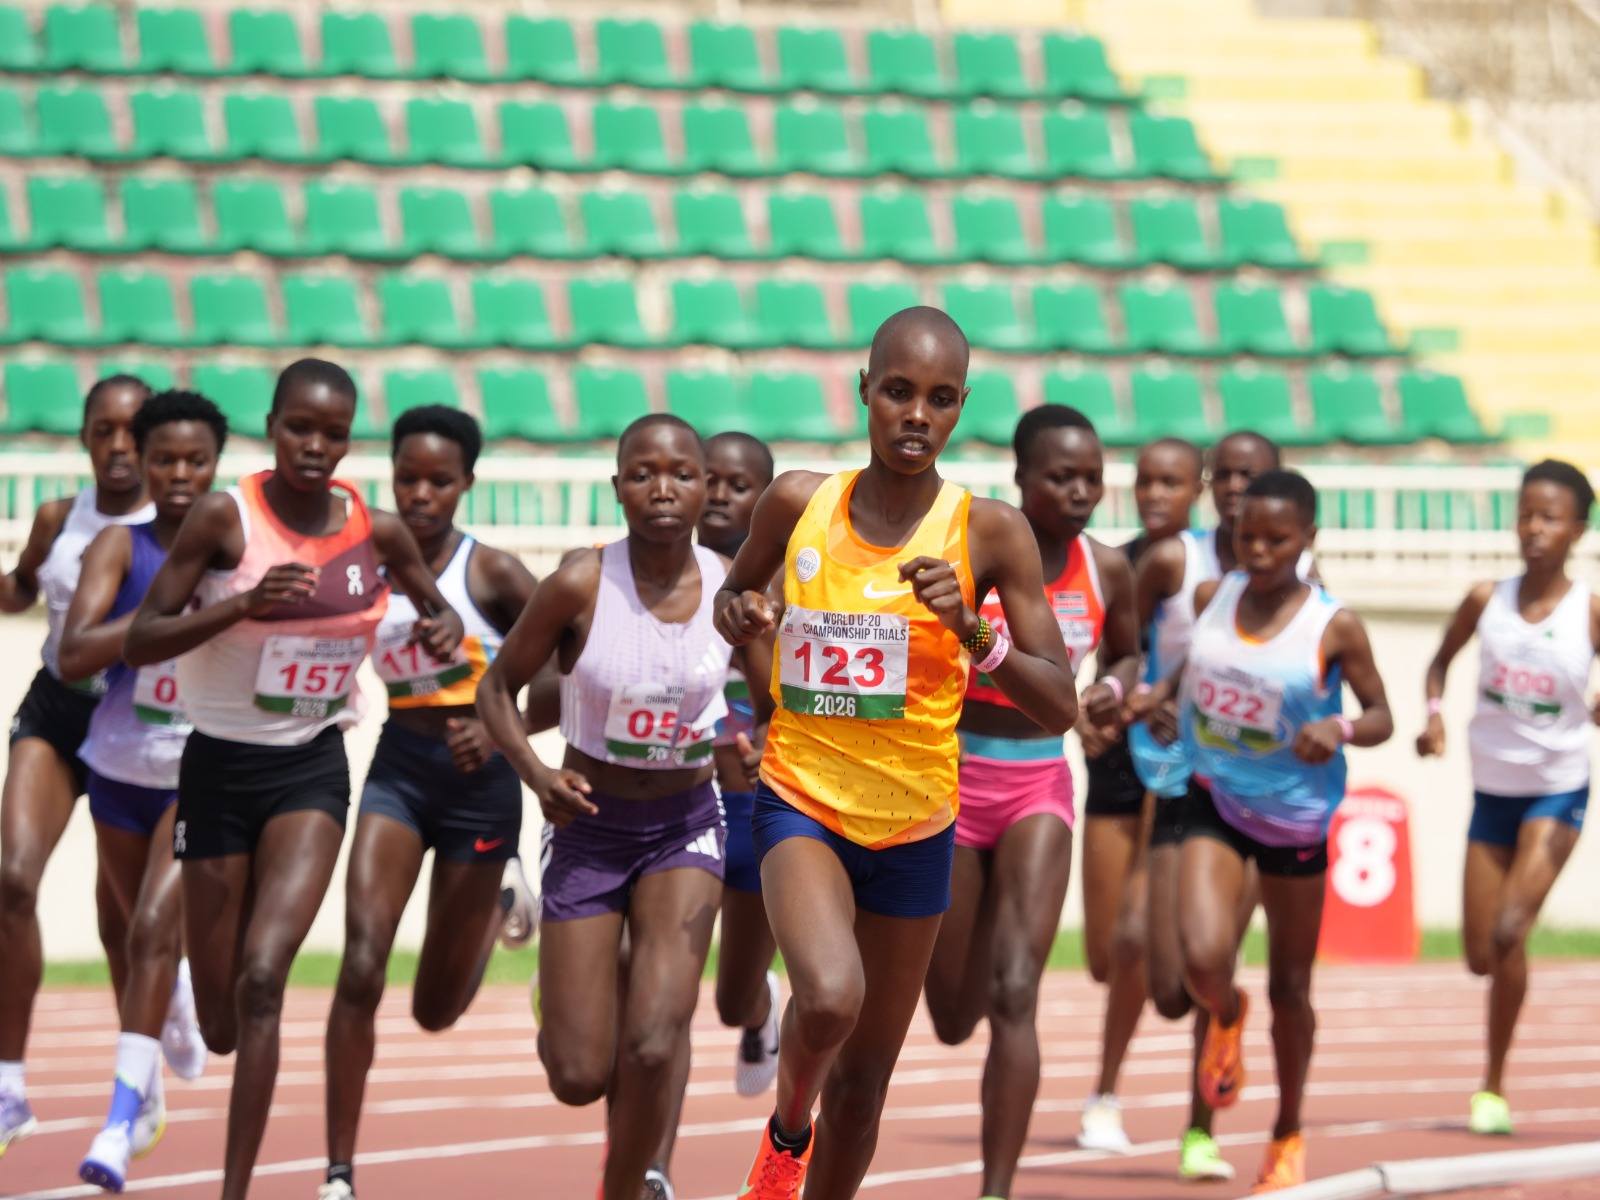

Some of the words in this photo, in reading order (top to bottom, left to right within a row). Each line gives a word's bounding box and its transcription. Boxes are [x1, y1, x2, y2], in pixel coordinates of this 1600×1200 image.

[802, 622, 871, 641] CHAMPIONSHIP
[873, 628, 907, 642] TRIALS
[821, 611, 855, 627] WORLD
[857, 614, 881, 627] U-20
[382, 643, 457, 677] 17
[794, 641, 886, 689] 123
[154, 675, 177, 705] 0
[280, 662, 352, 693] 157
[813, 693, 857, 718] 2026
[1199, 680, 1264, 724] 022
[1331, 816, 1398, 908] 8
